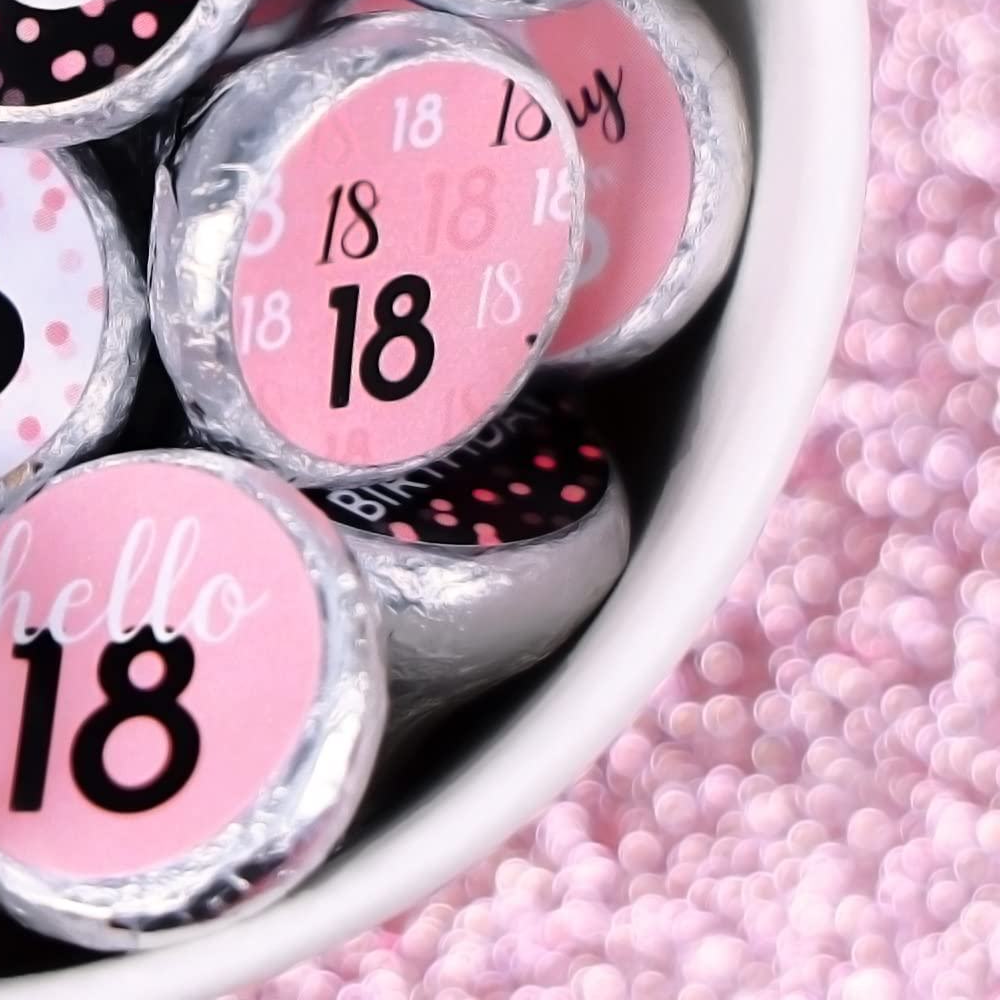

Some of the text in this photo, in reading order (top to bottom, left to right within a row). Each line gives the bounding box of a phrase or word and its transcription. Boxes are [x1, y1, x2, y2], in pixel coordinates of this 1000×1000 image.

[392, 93, 444, 152] 18
[316, 180, 380, 266] 18
[425, 166, 498, 257] 18
[239, 290, 292, 353] 18
[476, 259, 523, 329] 18
[329, 274, 436, 408] 18
[9, 625, 201, 814] 18
